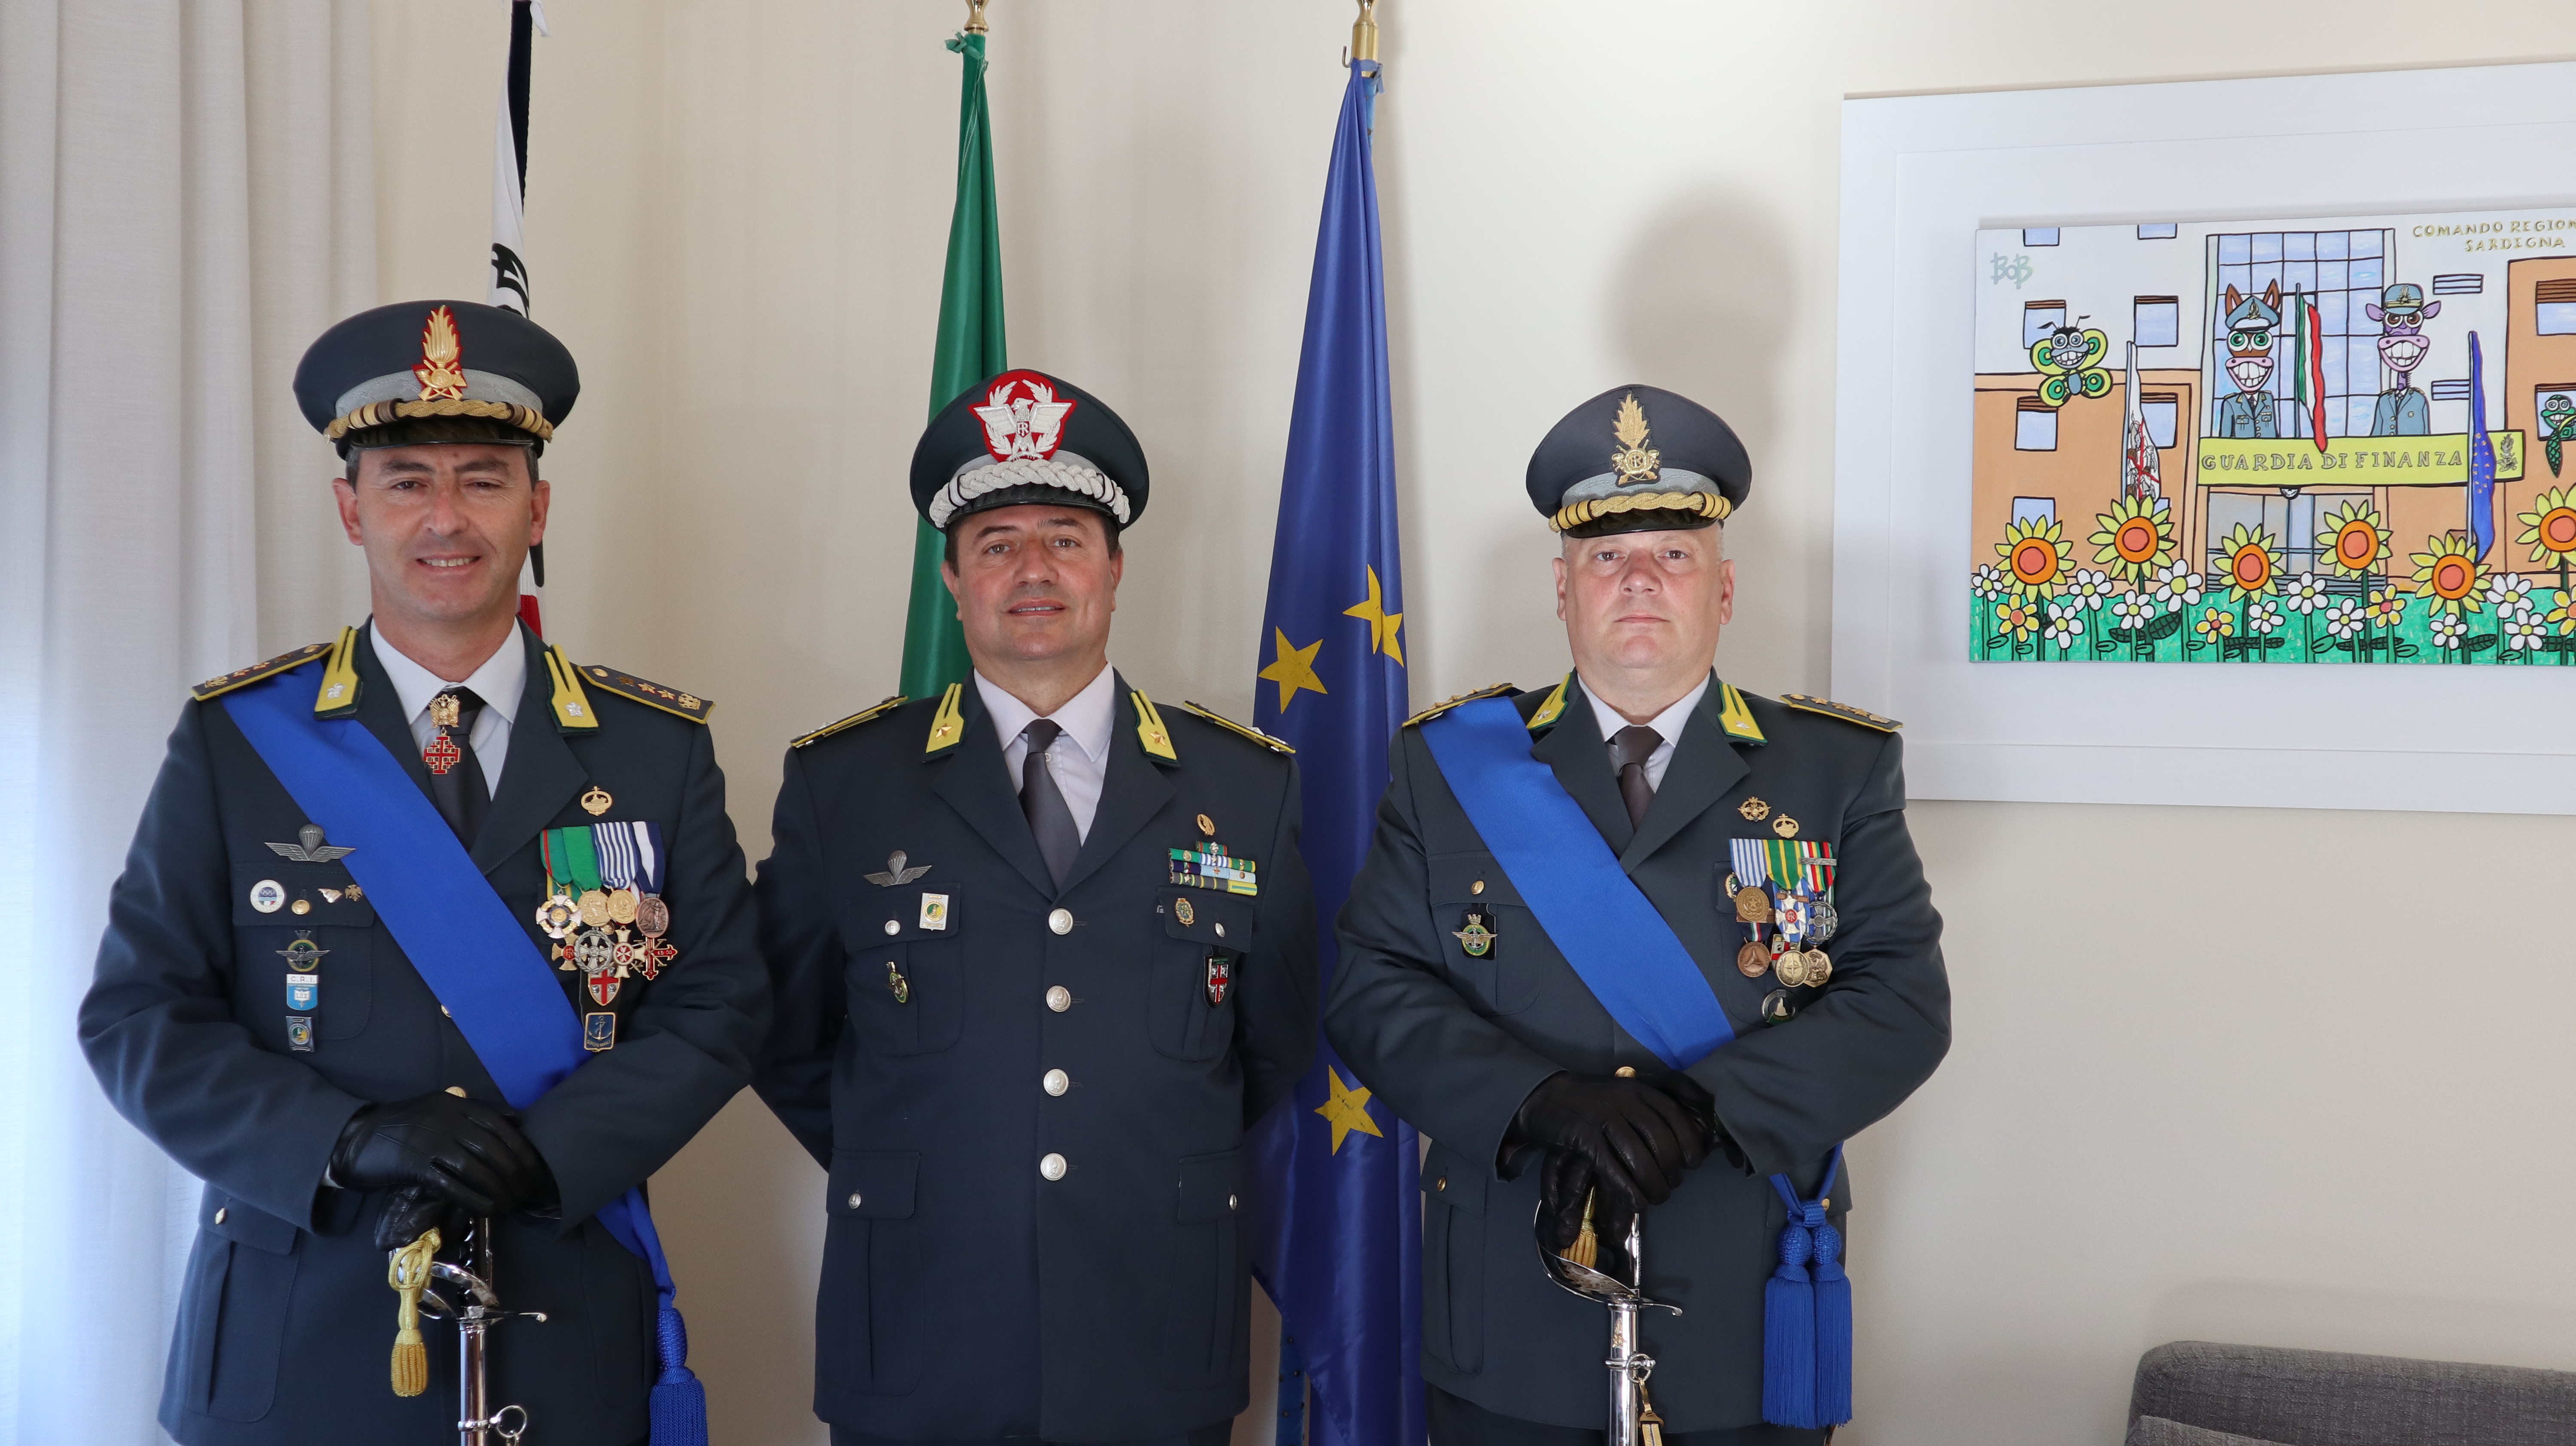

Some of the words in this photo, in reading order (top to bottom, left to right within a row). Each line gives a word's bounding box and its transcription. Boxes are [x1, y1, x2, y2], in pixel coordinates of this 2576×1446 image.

[2412, 221, 2503, 237] COMANDO
[2464, 237, 2566, 252] SARDEGNA
[2201, 453, 2313, 471] GUARDIA
[2321, 453, 2348, 469] DI
[2356, 450, 2463, 468] FINANZA
